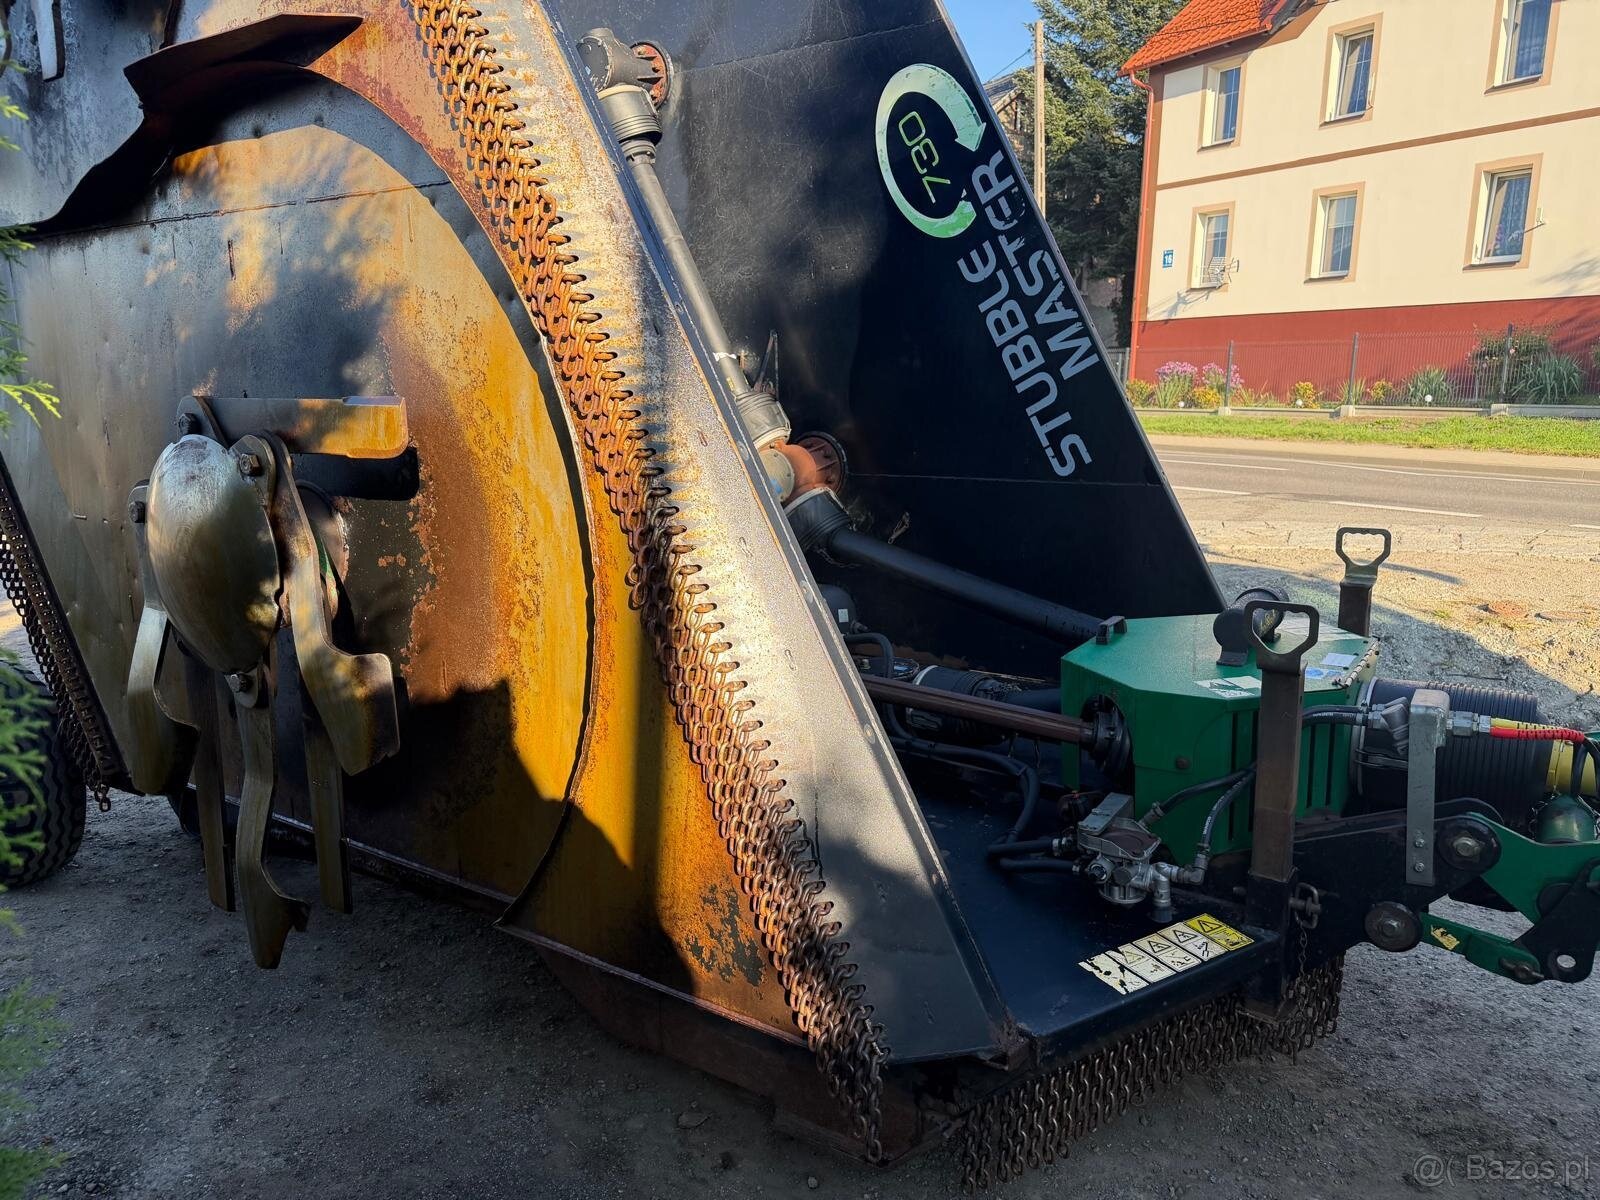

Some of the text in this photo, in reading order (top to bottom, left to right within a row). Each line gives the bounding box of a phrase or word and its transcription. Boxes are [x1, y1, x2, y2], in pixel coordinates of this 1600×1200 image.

[898, 111, 951, 204] 730
[971, 149, 1100, 381] MASTER
[957, 239, 1094, 478] STUBBLE
